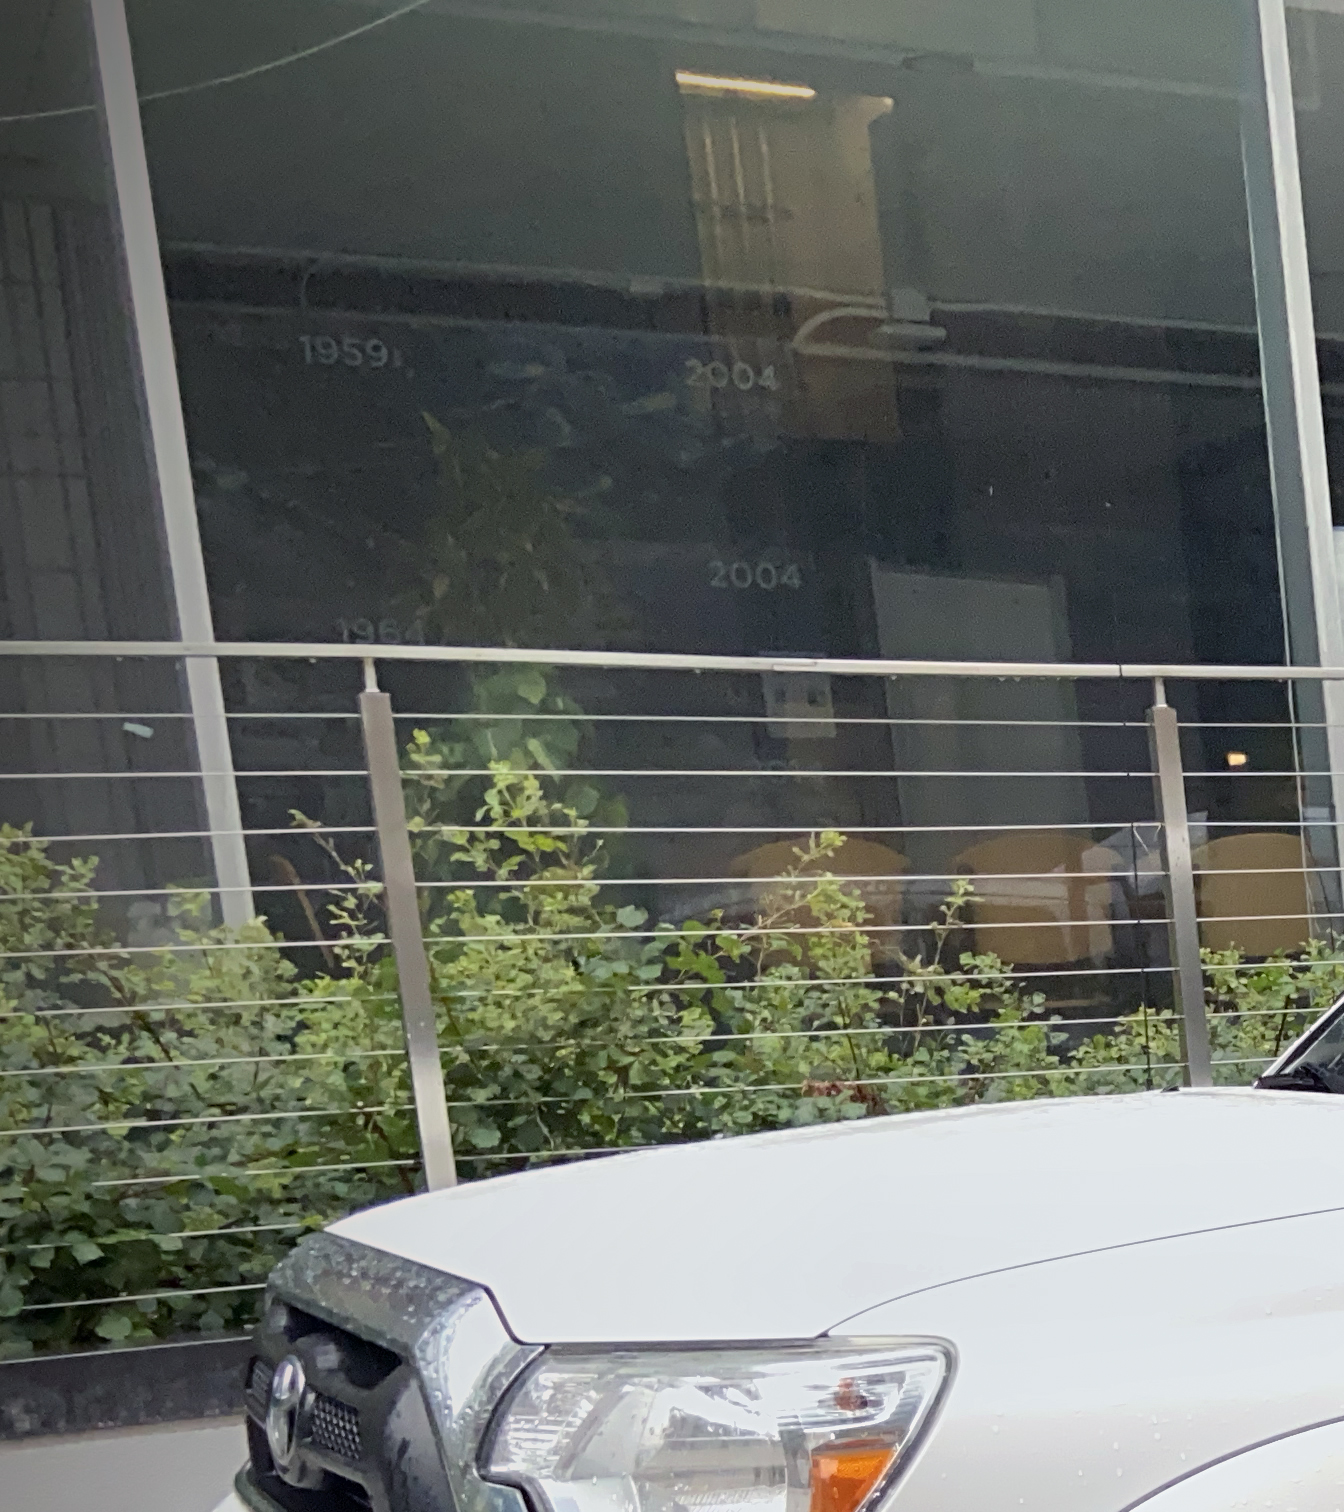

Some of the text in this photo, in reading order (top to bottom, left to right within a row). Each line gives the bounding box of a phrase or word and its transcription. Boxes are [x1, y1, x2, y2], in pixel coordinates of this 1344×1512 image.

[298, 334, 389, 368] 1959
[684, 357, 780, 391] 2004
[707, 559, 802, 591] 2004
